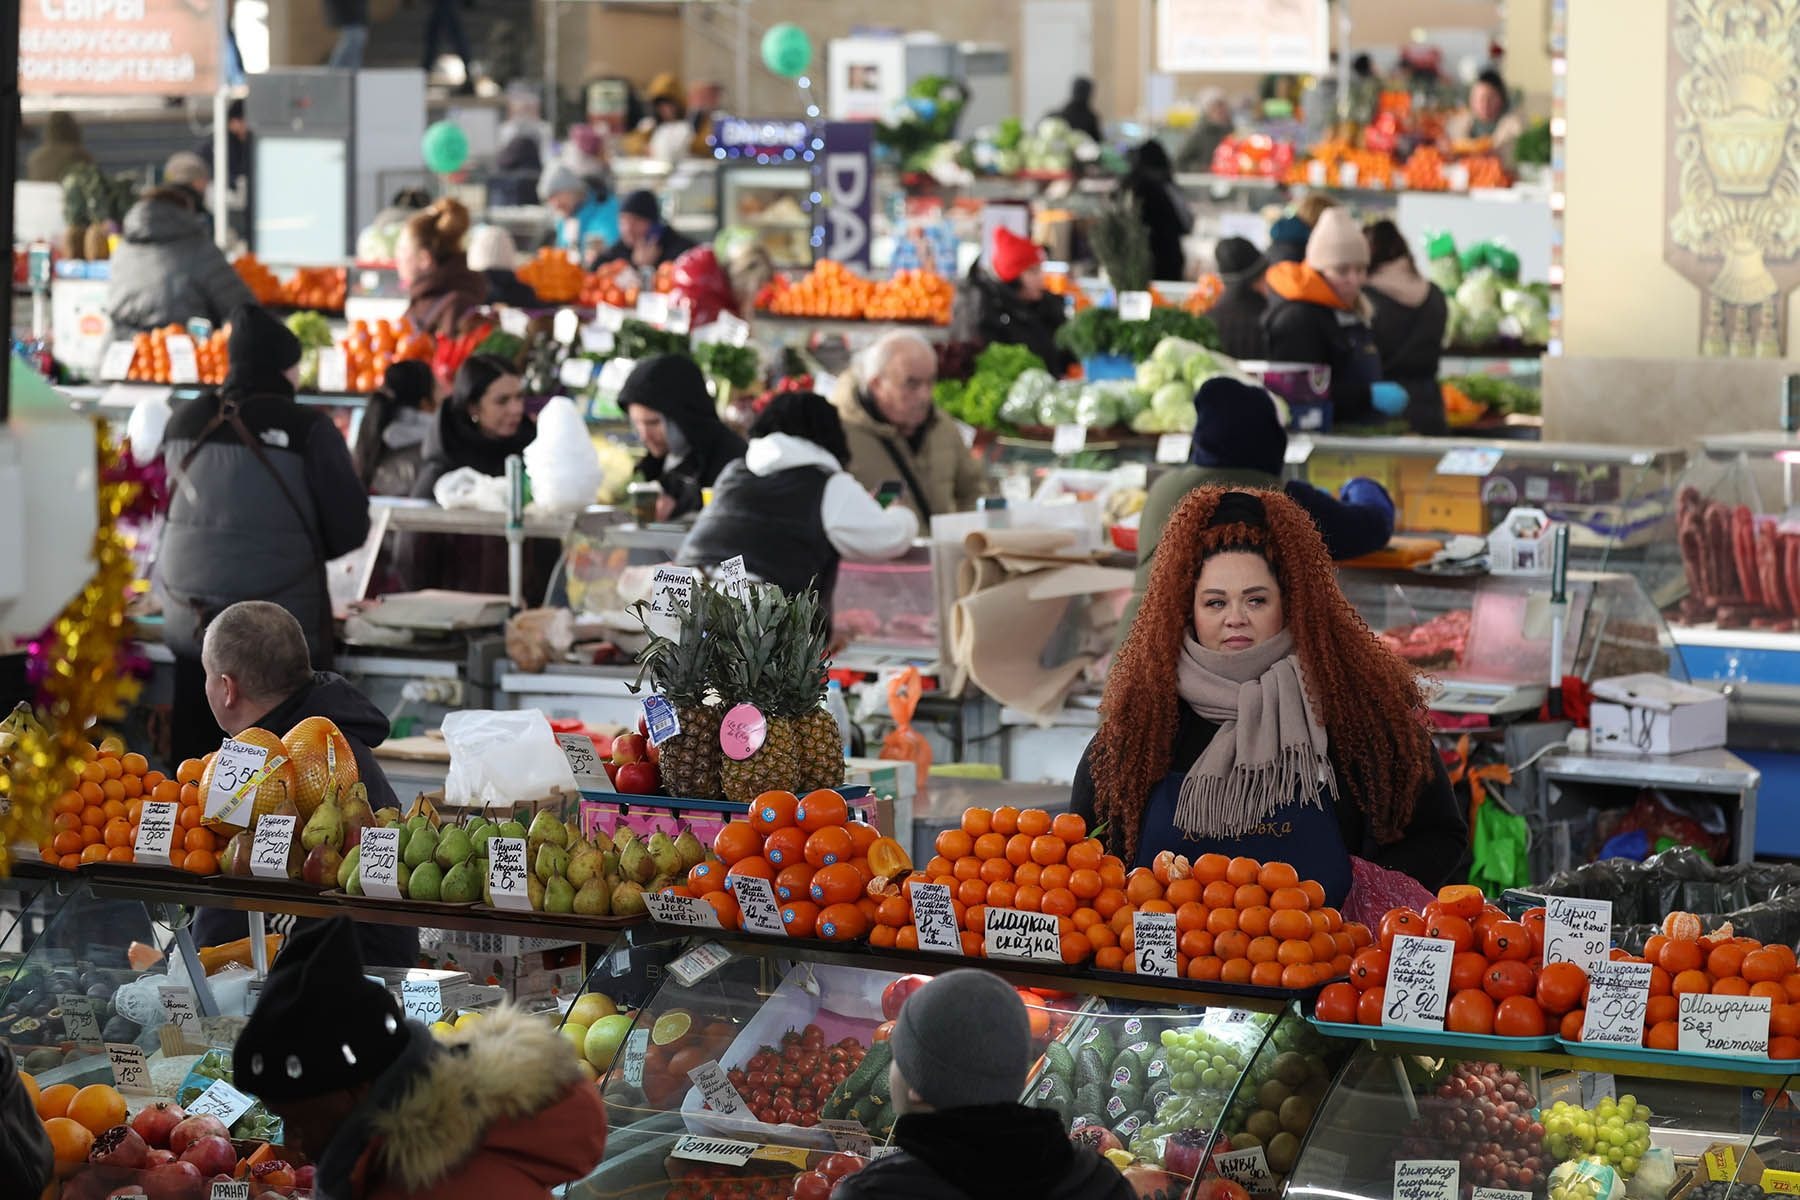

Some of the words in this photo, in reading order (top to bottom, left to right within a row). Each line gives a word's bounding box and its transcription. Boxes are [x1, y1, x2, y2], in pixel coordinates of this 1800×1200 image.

[1548, 898, 1597, 928] Хурма
[996, 935, 1059, 958] сказка!
[1584, 940, 1605, 955] 90
[1681, 993, 1771, 1022] Мандарин
[213, 1182, 249, 1198] ГРАНАТ
